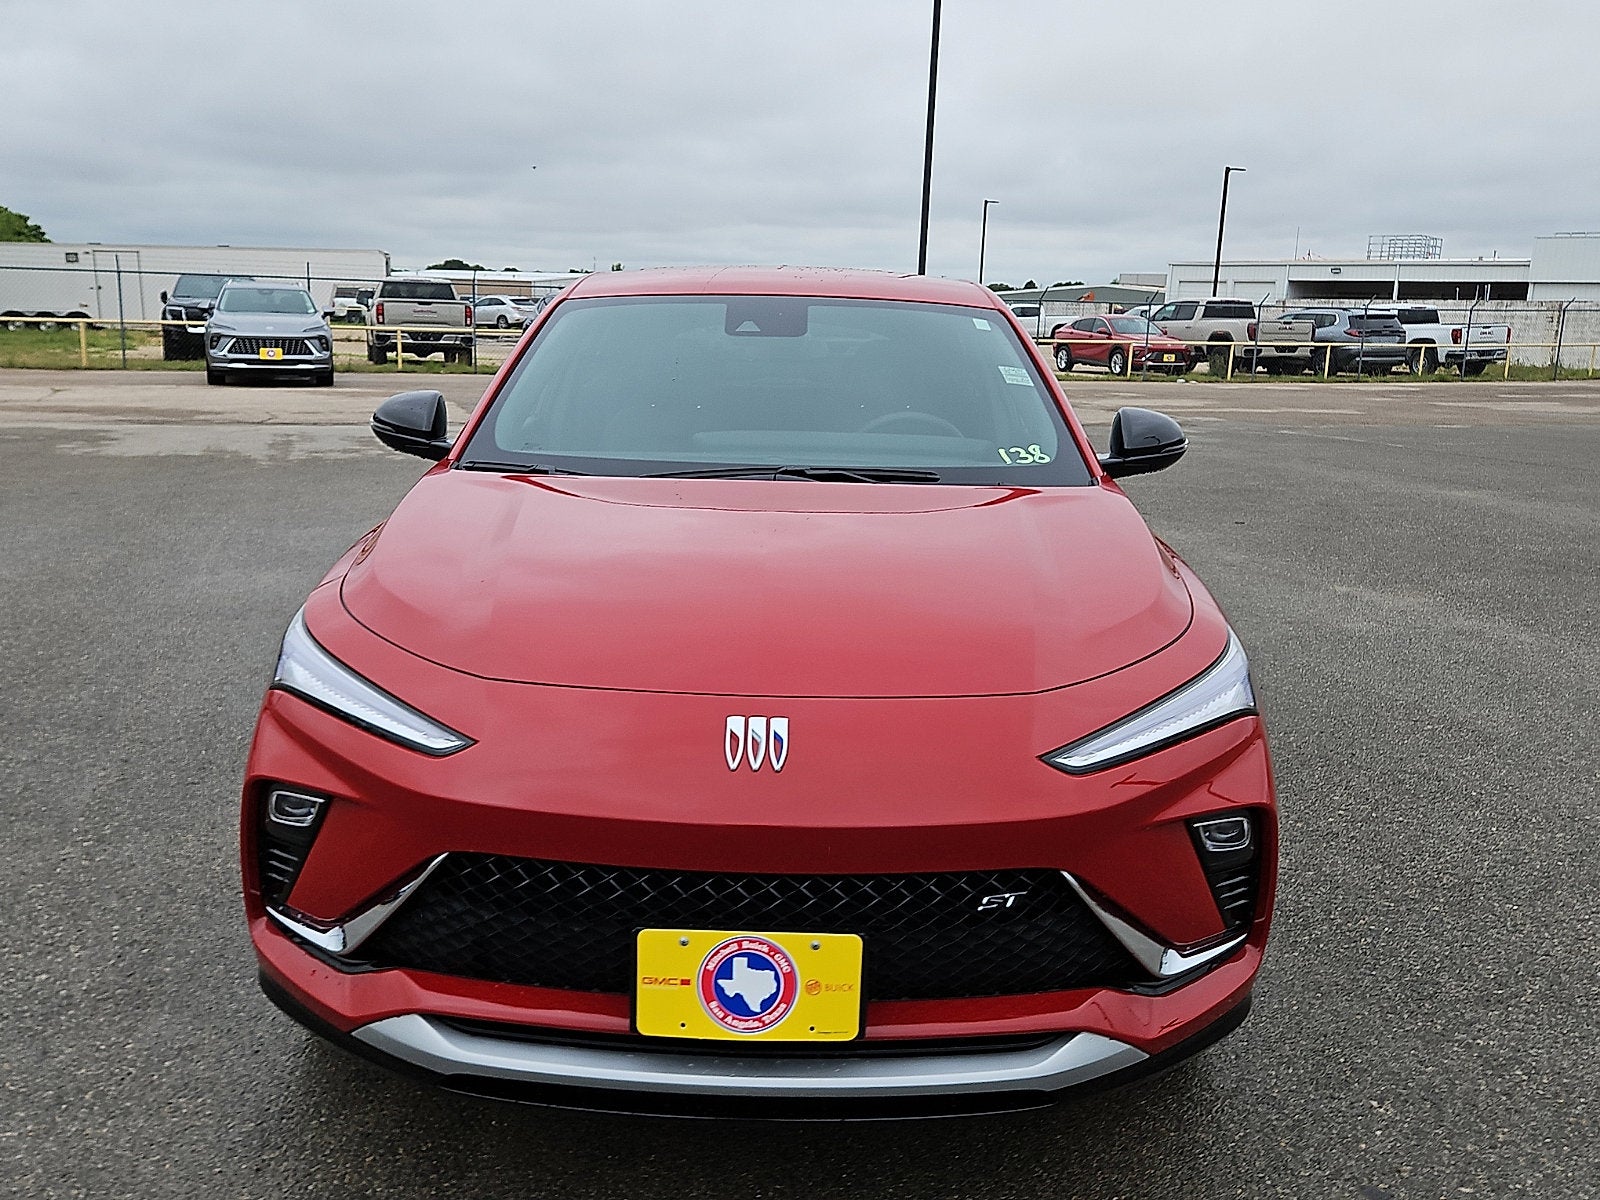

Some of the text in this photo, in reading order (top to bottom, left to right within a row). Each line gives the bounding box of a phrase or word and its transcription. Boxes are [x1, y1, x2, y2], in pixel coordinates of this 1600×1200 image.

[997, 444, 1051, 465] 138
[977, 891, 1028, 911] ST
[641, 976, 679, 986] GMC
[824, 983, 854, 993] BUICK
[708, 1000, 725, 1019] San
